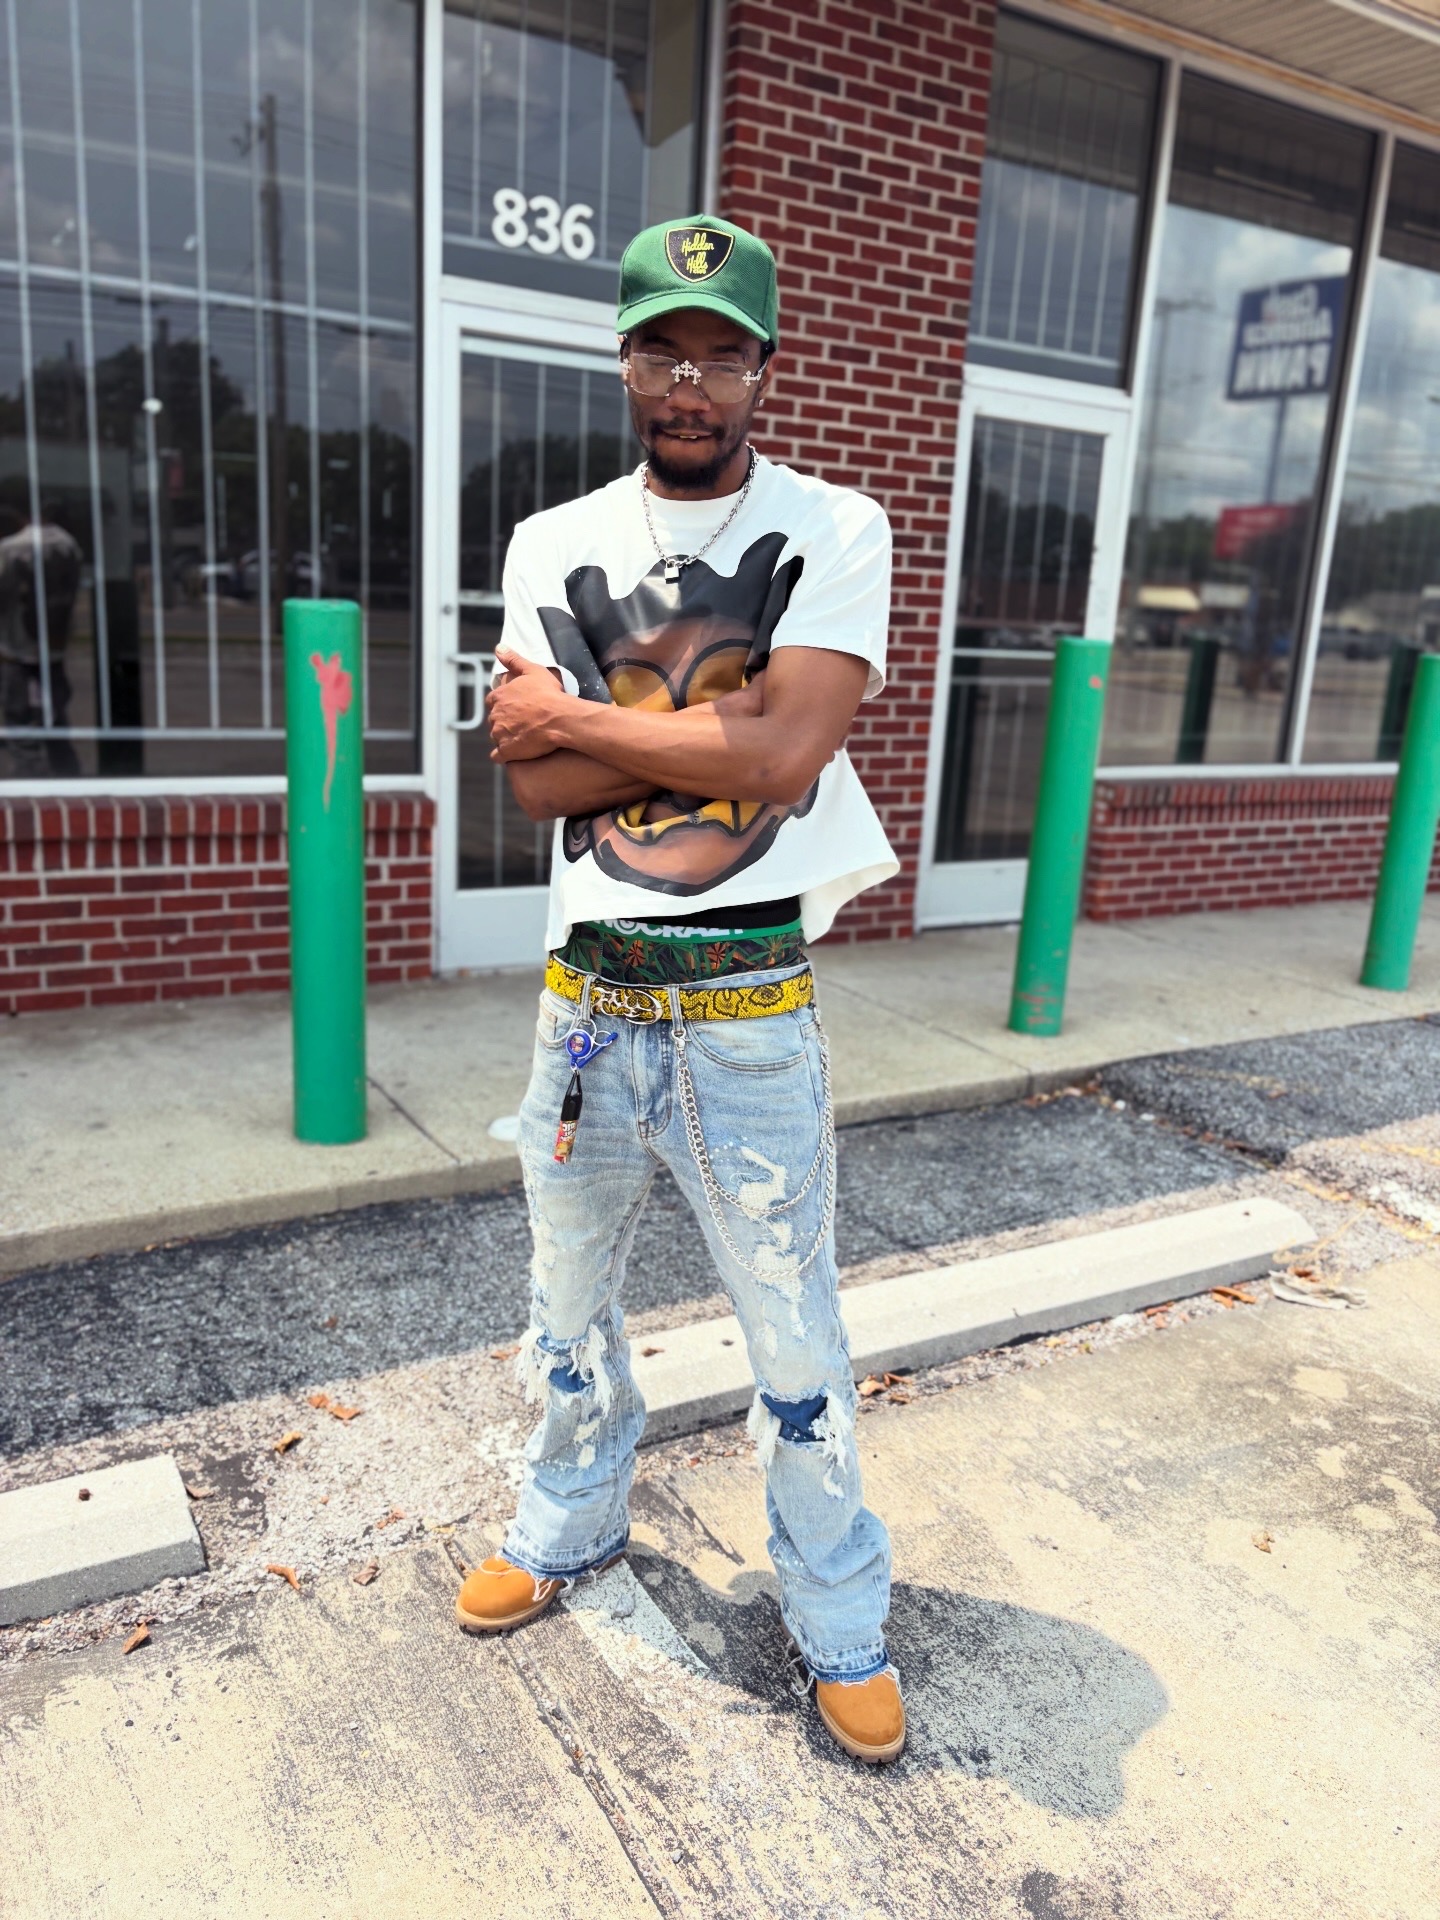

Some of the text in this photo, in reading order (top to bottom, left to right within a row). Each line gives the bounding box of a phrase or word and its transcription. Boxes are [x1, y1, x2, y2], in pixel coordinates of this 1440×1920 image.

[492, 187, 595, 260] 836
[682, 232, 714, 256] Hidden
[686, 251, 708, 273] Hills
